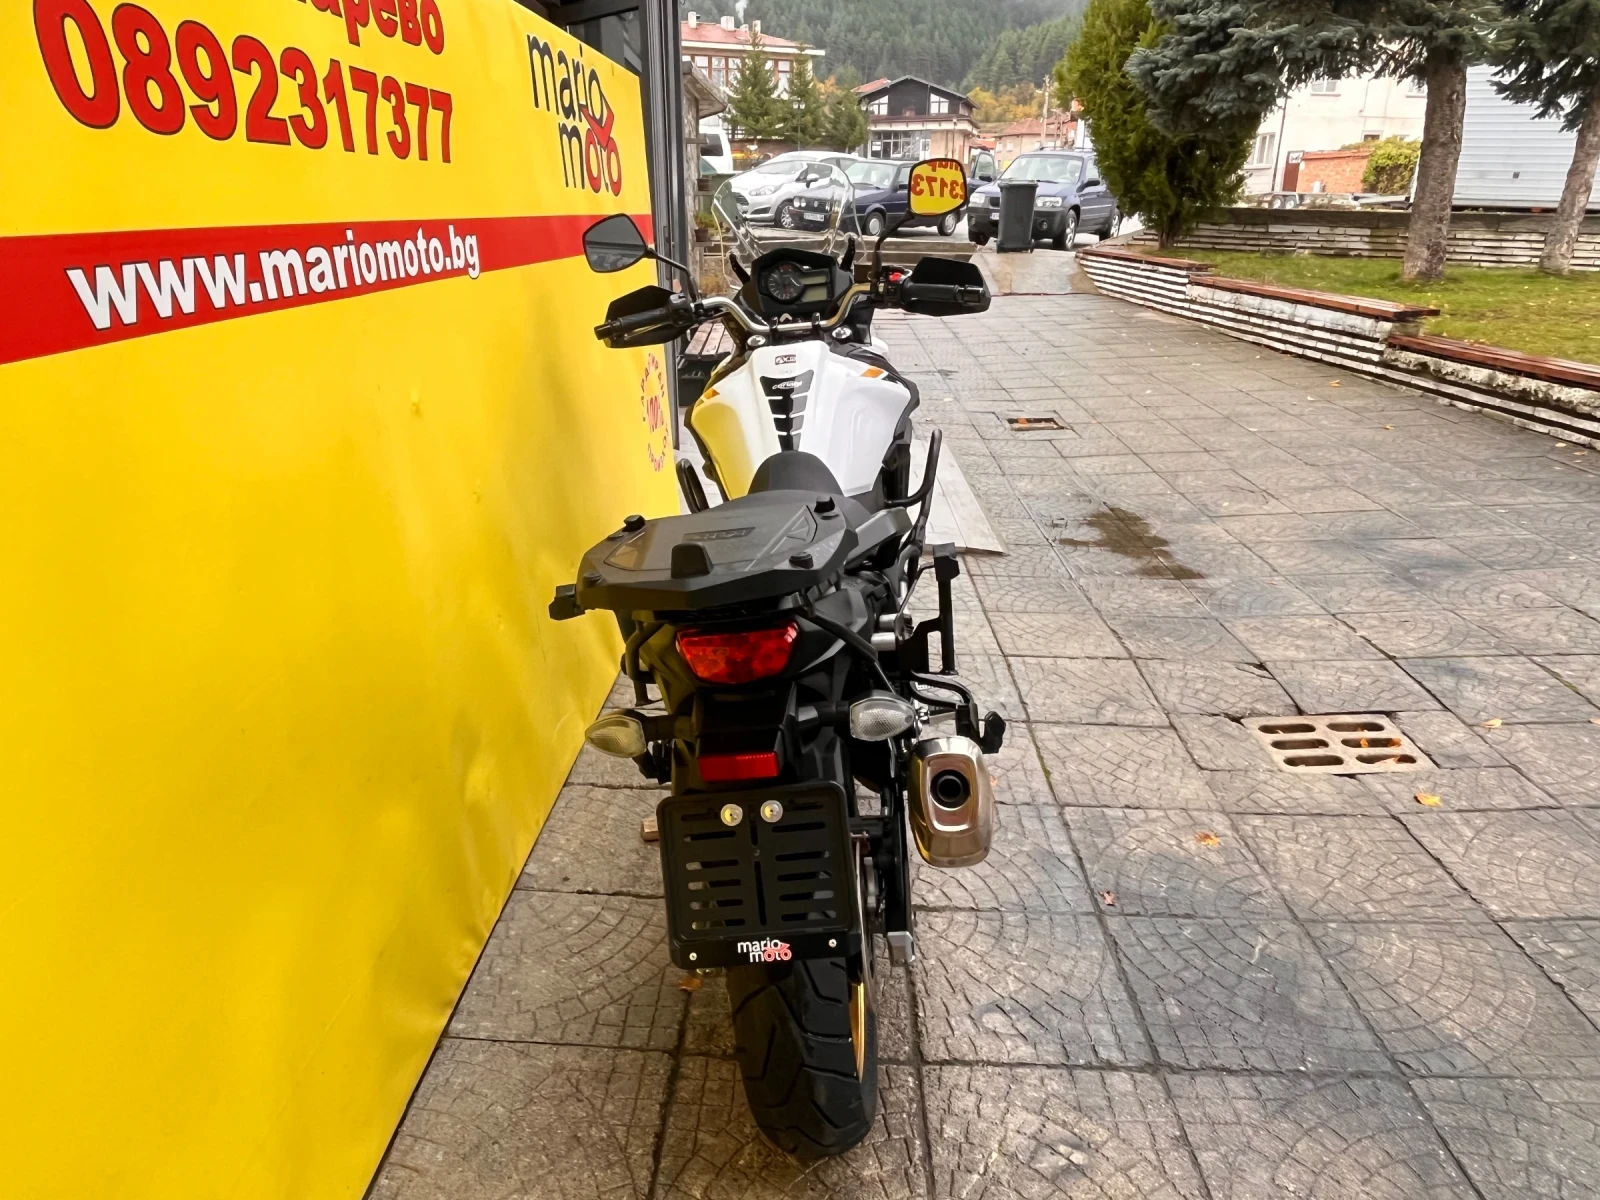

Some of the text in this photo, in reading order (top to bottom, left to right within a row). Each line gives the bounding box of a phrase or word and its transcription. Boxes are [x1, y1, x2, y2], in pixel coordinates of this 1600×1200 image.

[33, 0, 453, 164] 0892317377
[526, 34, 606, 128] mario
[558, 121, 622, 197] moto
[66, 224, 481, 330] www.mariomoto.bg
[737, 936, 781, 953] mario
[749, 948, 793, 962] moto
